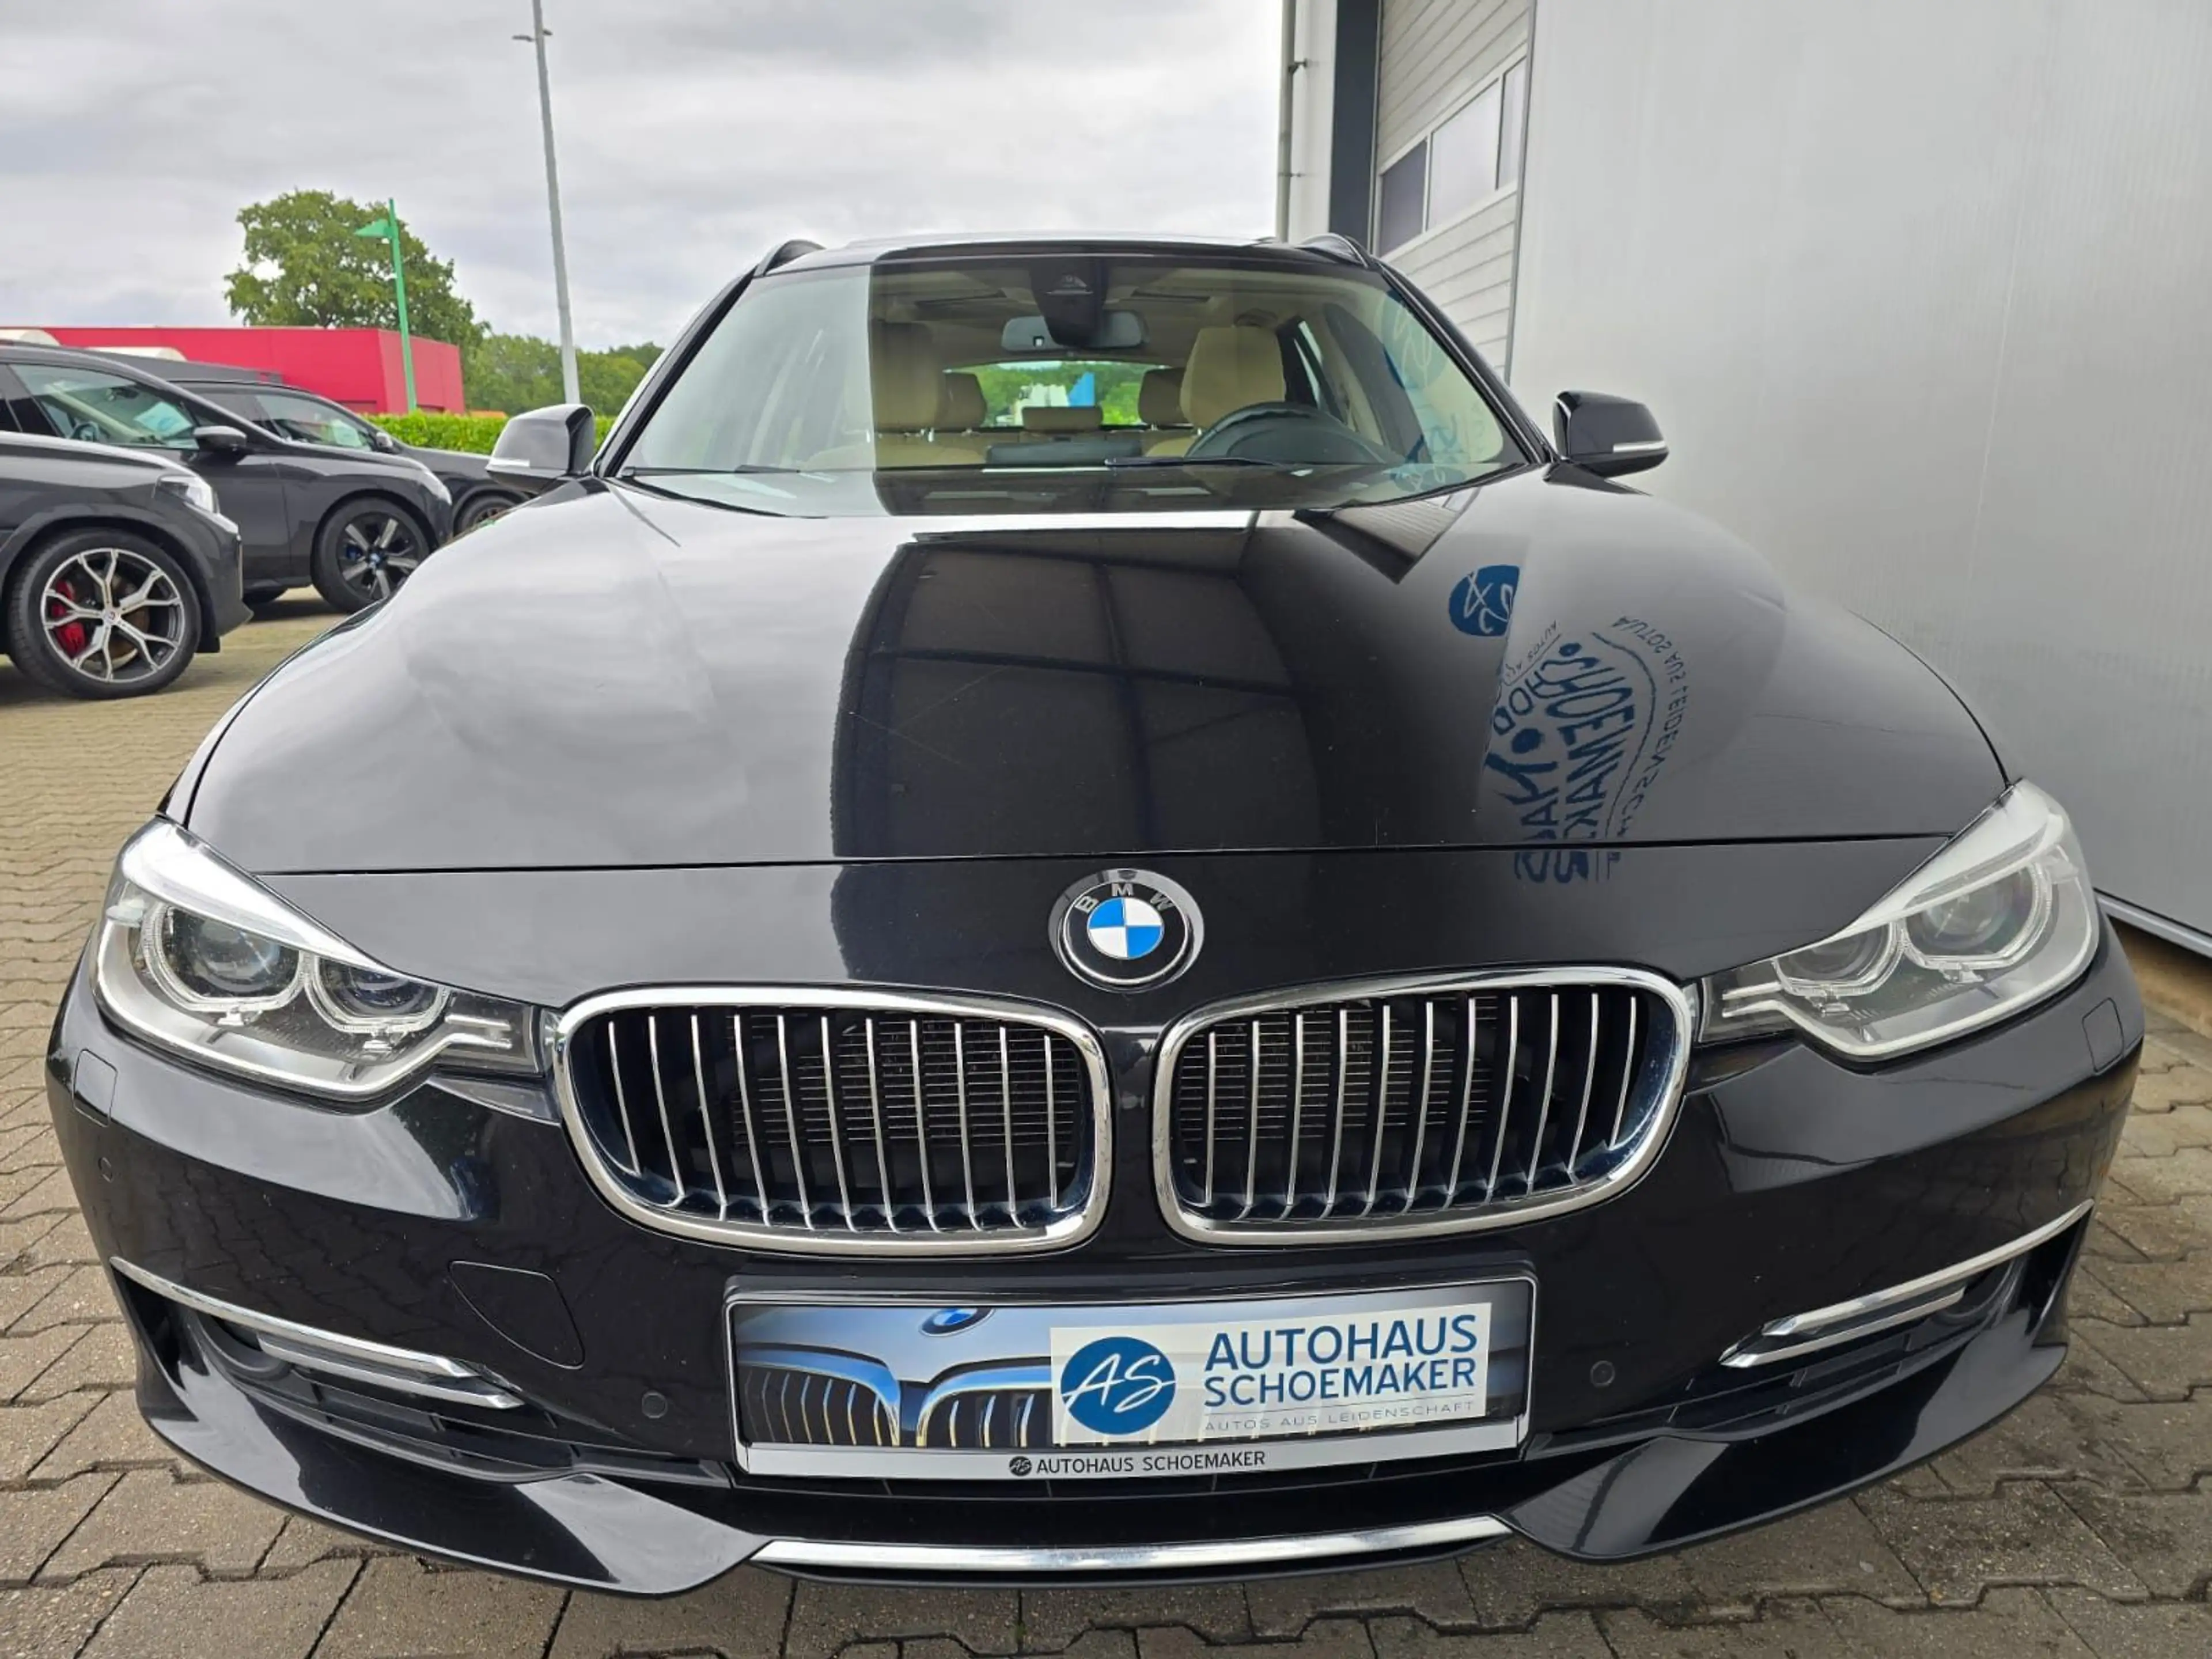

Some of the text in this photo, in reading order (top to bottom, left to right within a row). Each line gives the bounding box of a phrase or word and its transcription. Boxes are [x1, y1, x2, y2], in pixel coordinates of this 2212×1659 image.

[1074, 882, 1175, 914] BMW
[1204, 1314, 1478, 1372] AUTOHAUS
[1062, 1353, 1176, 1413] AS
[1204, 1357, 1476, 1407] SCHOEMAKER
[1205, 1401, 1474, 1433] AUTOS AUS LEIDENSCHAFT
[1036, 1457, 1134, 1474] AUTOHAUS
[1142, 1450, 1266, 1471] SCHOEMAKER
